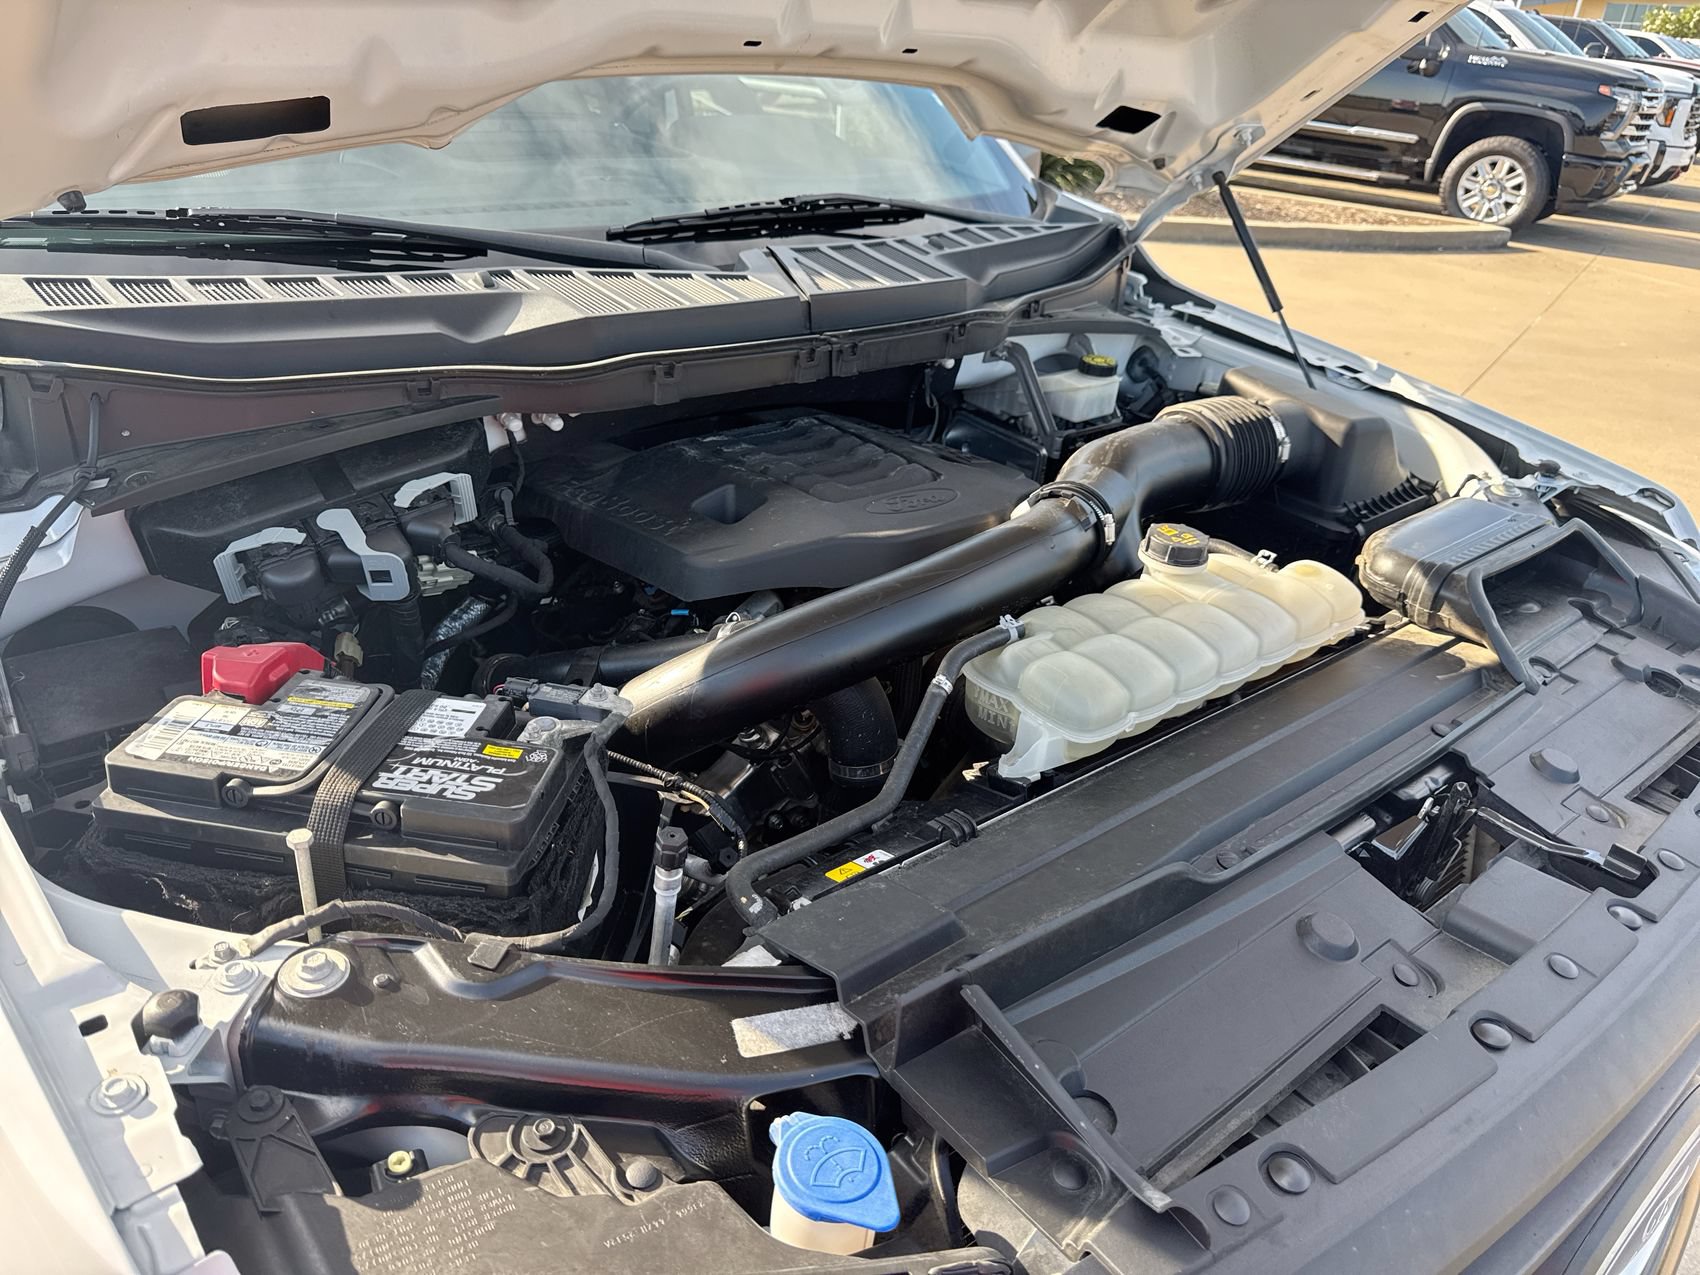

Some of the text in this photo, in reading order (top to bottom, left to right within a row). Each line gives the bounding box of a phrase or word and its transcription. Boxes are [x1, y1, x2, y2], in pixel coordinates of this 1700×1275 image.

[979, 691, 1009, 713] MAX
[978, 705, 1008, 729] MIN
[411, 757, 507, 775] PLATINUM
[372, 776, 477, 801] SUPER
[378, 766, 504, 792] START
[480, 1194, 512, 1212] LOWER
[484, 1203, 516, 1222] UPPER
